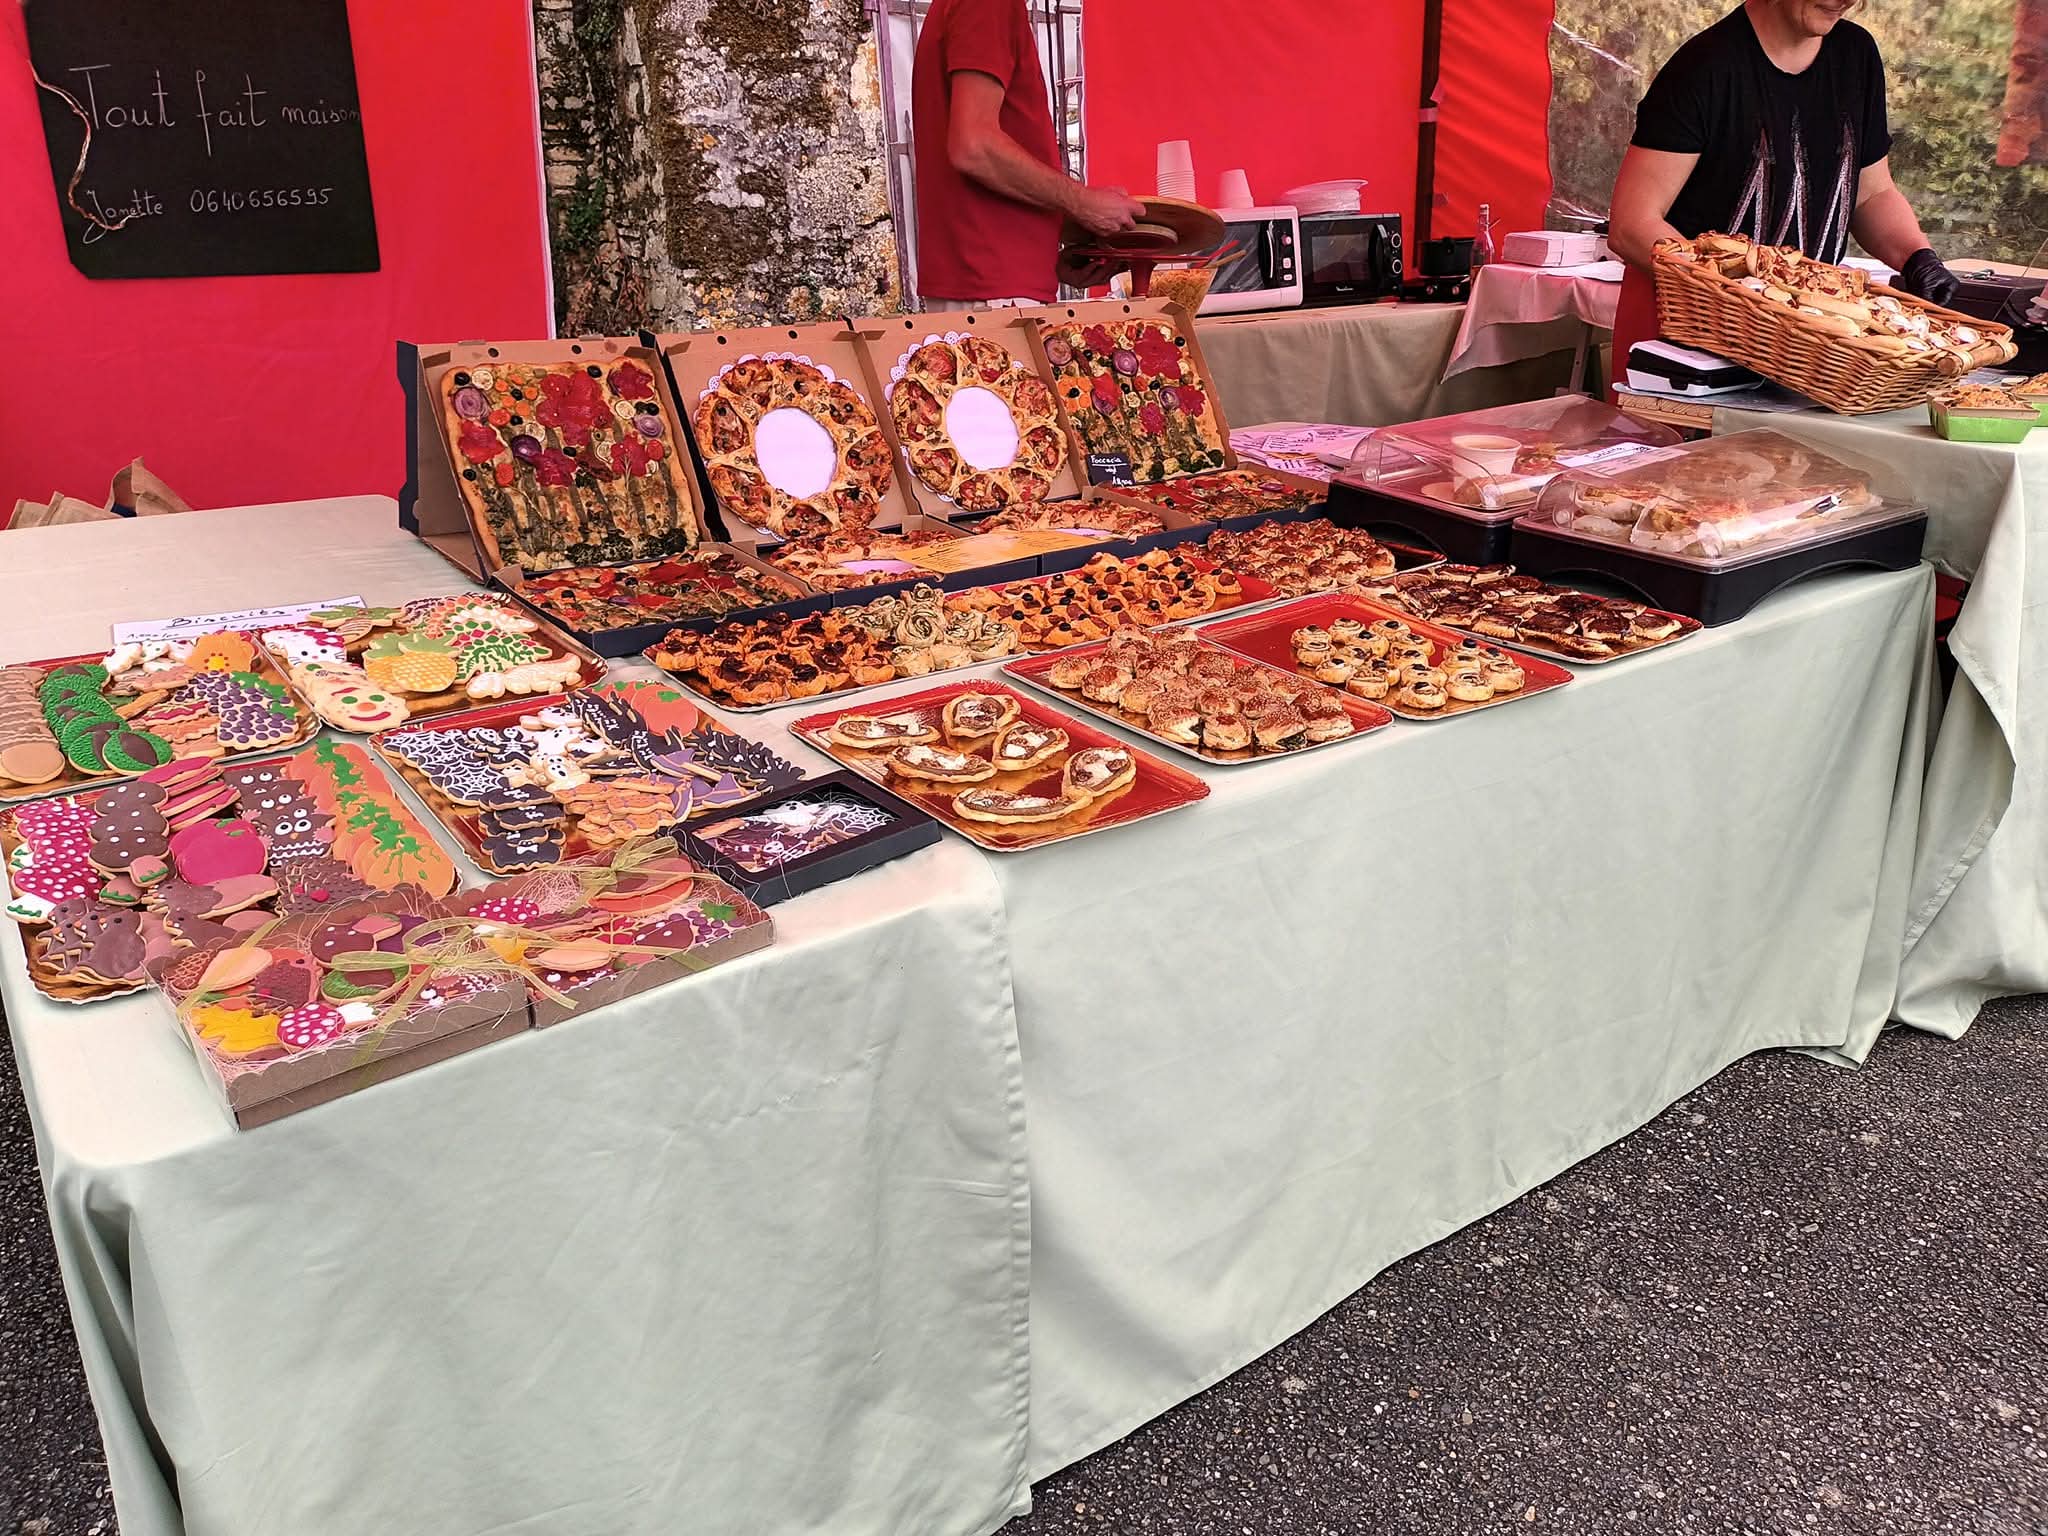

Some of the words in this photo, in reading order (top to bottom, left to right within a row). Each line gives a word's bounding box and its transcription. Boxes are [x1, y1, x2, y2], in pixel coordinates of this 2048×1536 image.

[68, 63, 176, 130] Tout
[195, 69, 267, 157] fait
[282, 99, 361, 126] maison
[190, 187, 335, 213] 0640656595
